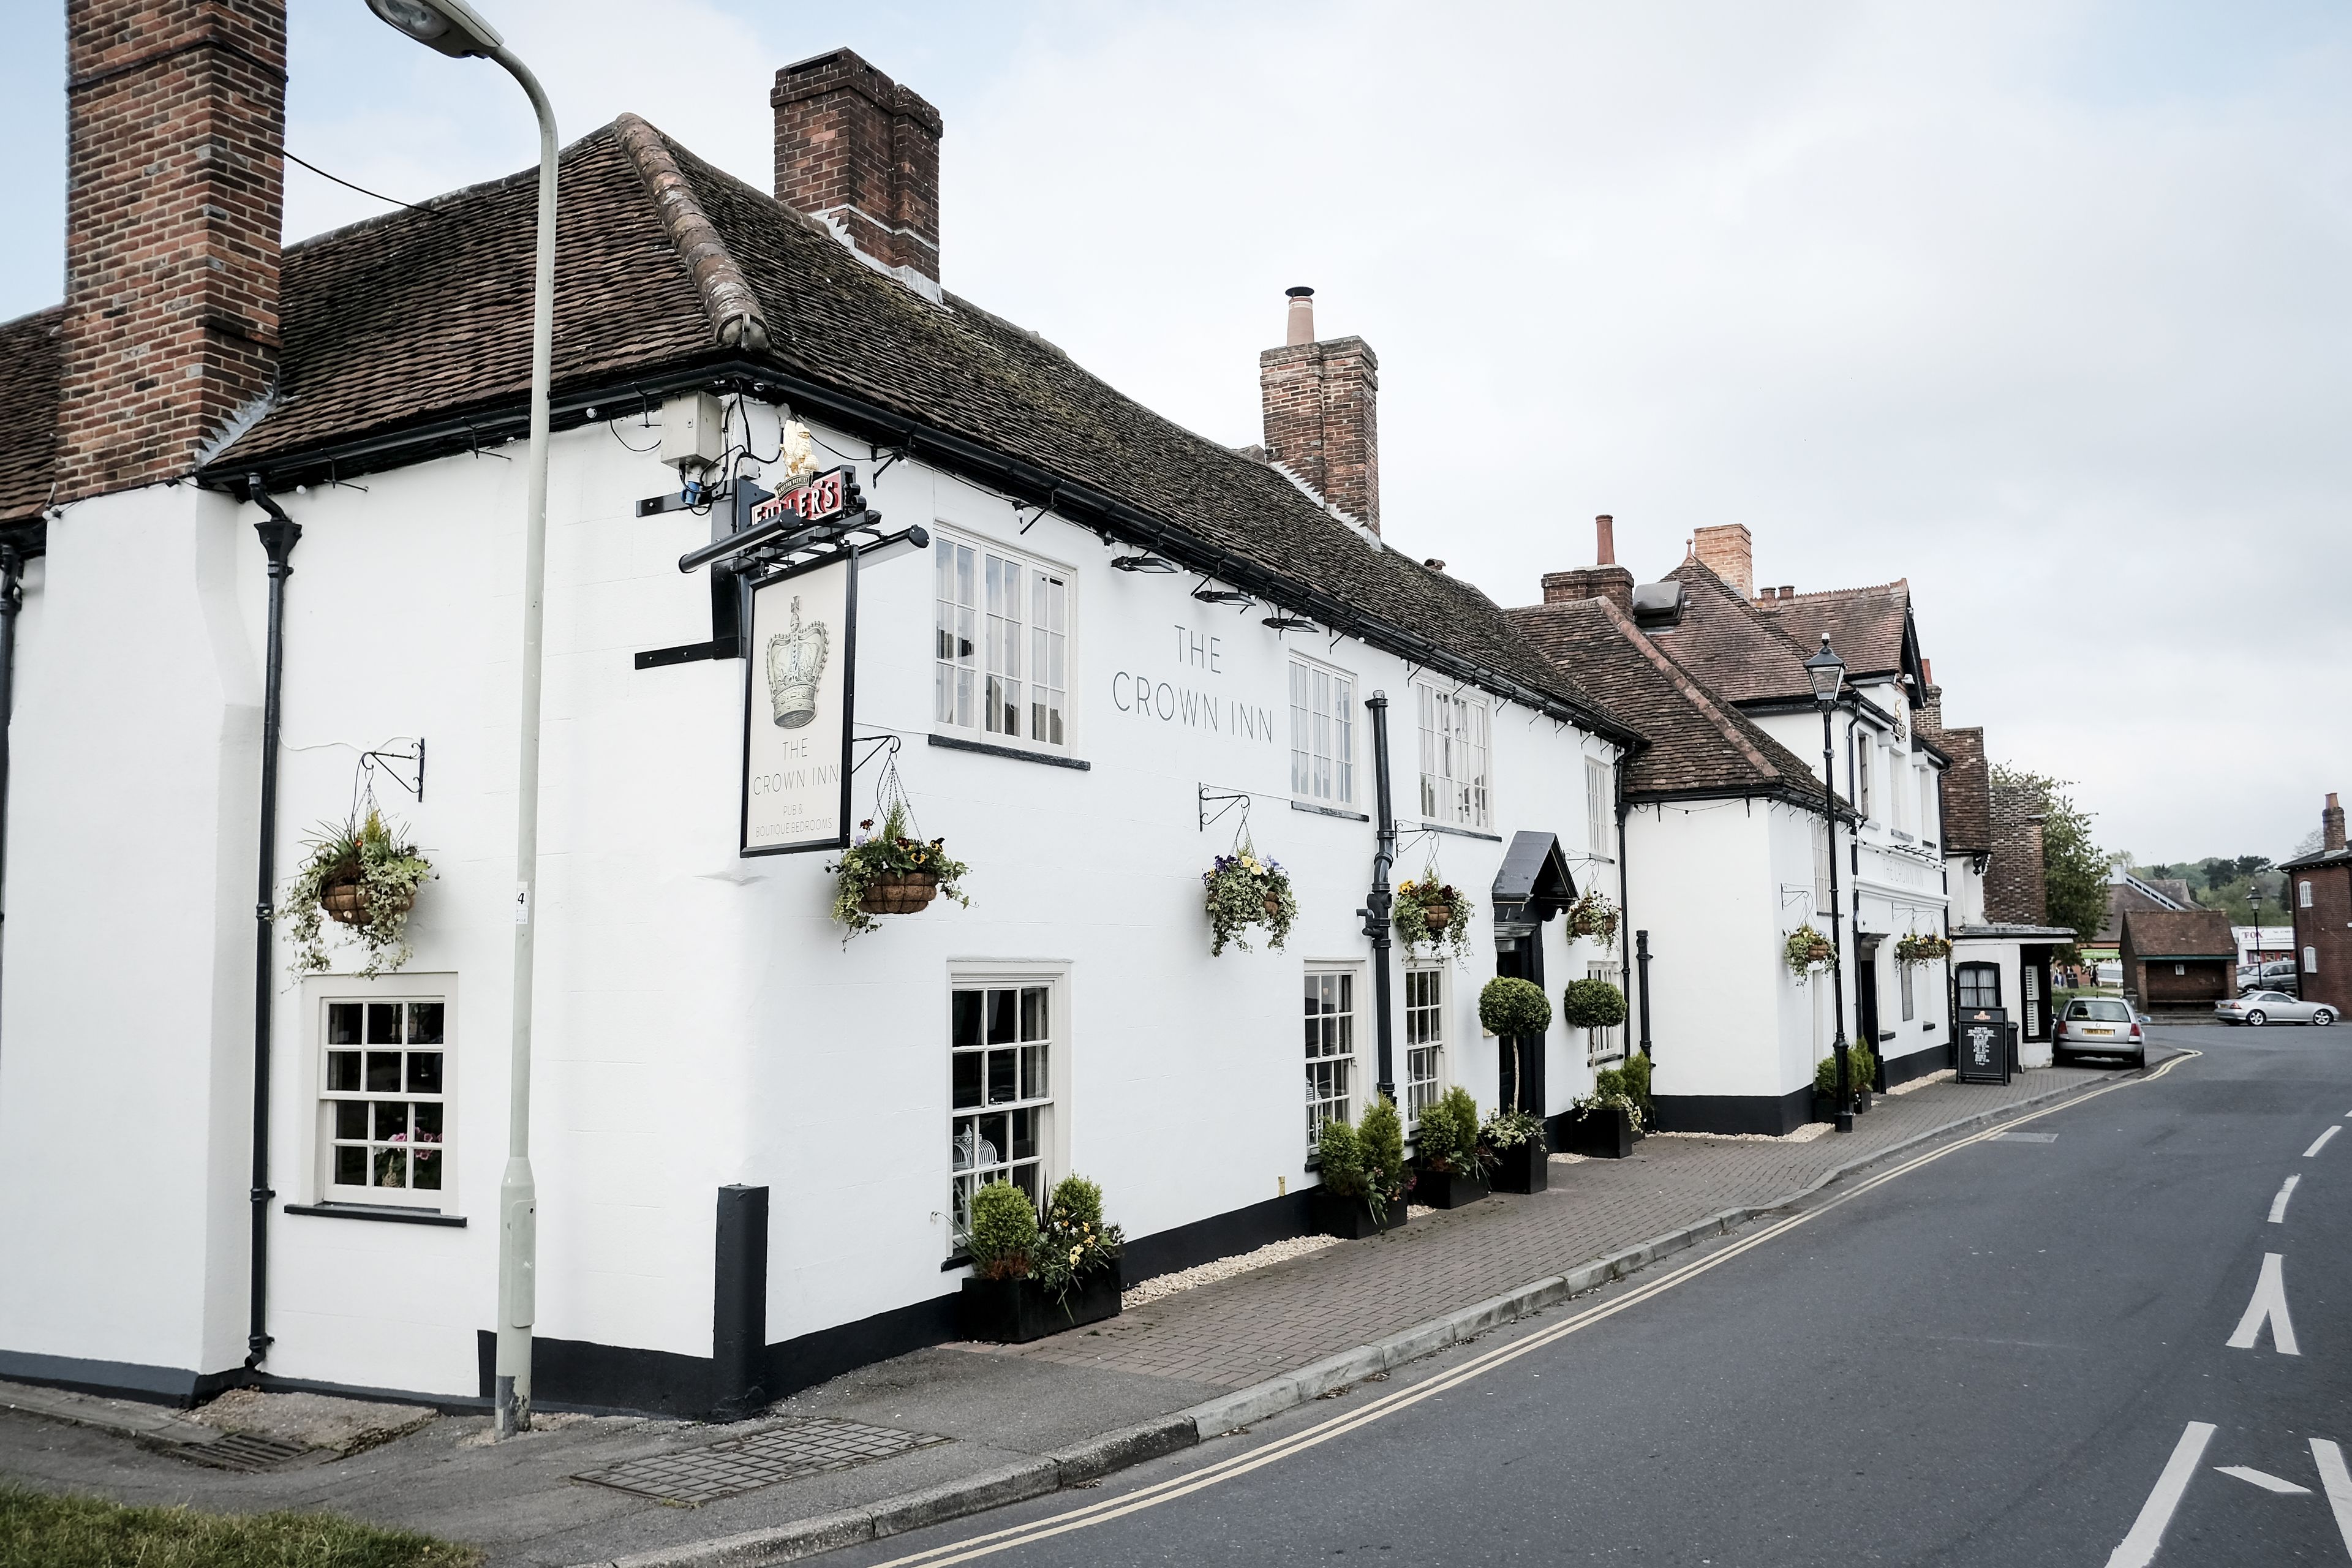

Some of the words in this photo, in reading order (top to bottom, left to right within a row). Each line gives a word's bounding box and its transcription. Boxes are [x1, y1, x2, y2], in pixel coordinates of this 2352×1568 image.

[1174, 625, 1221, 674] THE
[1113, 671, 1218, 732] CROWN
[1231, 701, 1272, 744] INN
[783, 737, 808, 760] THE
[753, 769, 805, 795] CROWN
[812, 764, 839, 786] INN
[783, 804, 797, 816] PUB
[798, 804, 803, 815] &
[756, 823, 790, 837] BOUTIQUE
[791, 818, 832, 833] BEDROOMS
